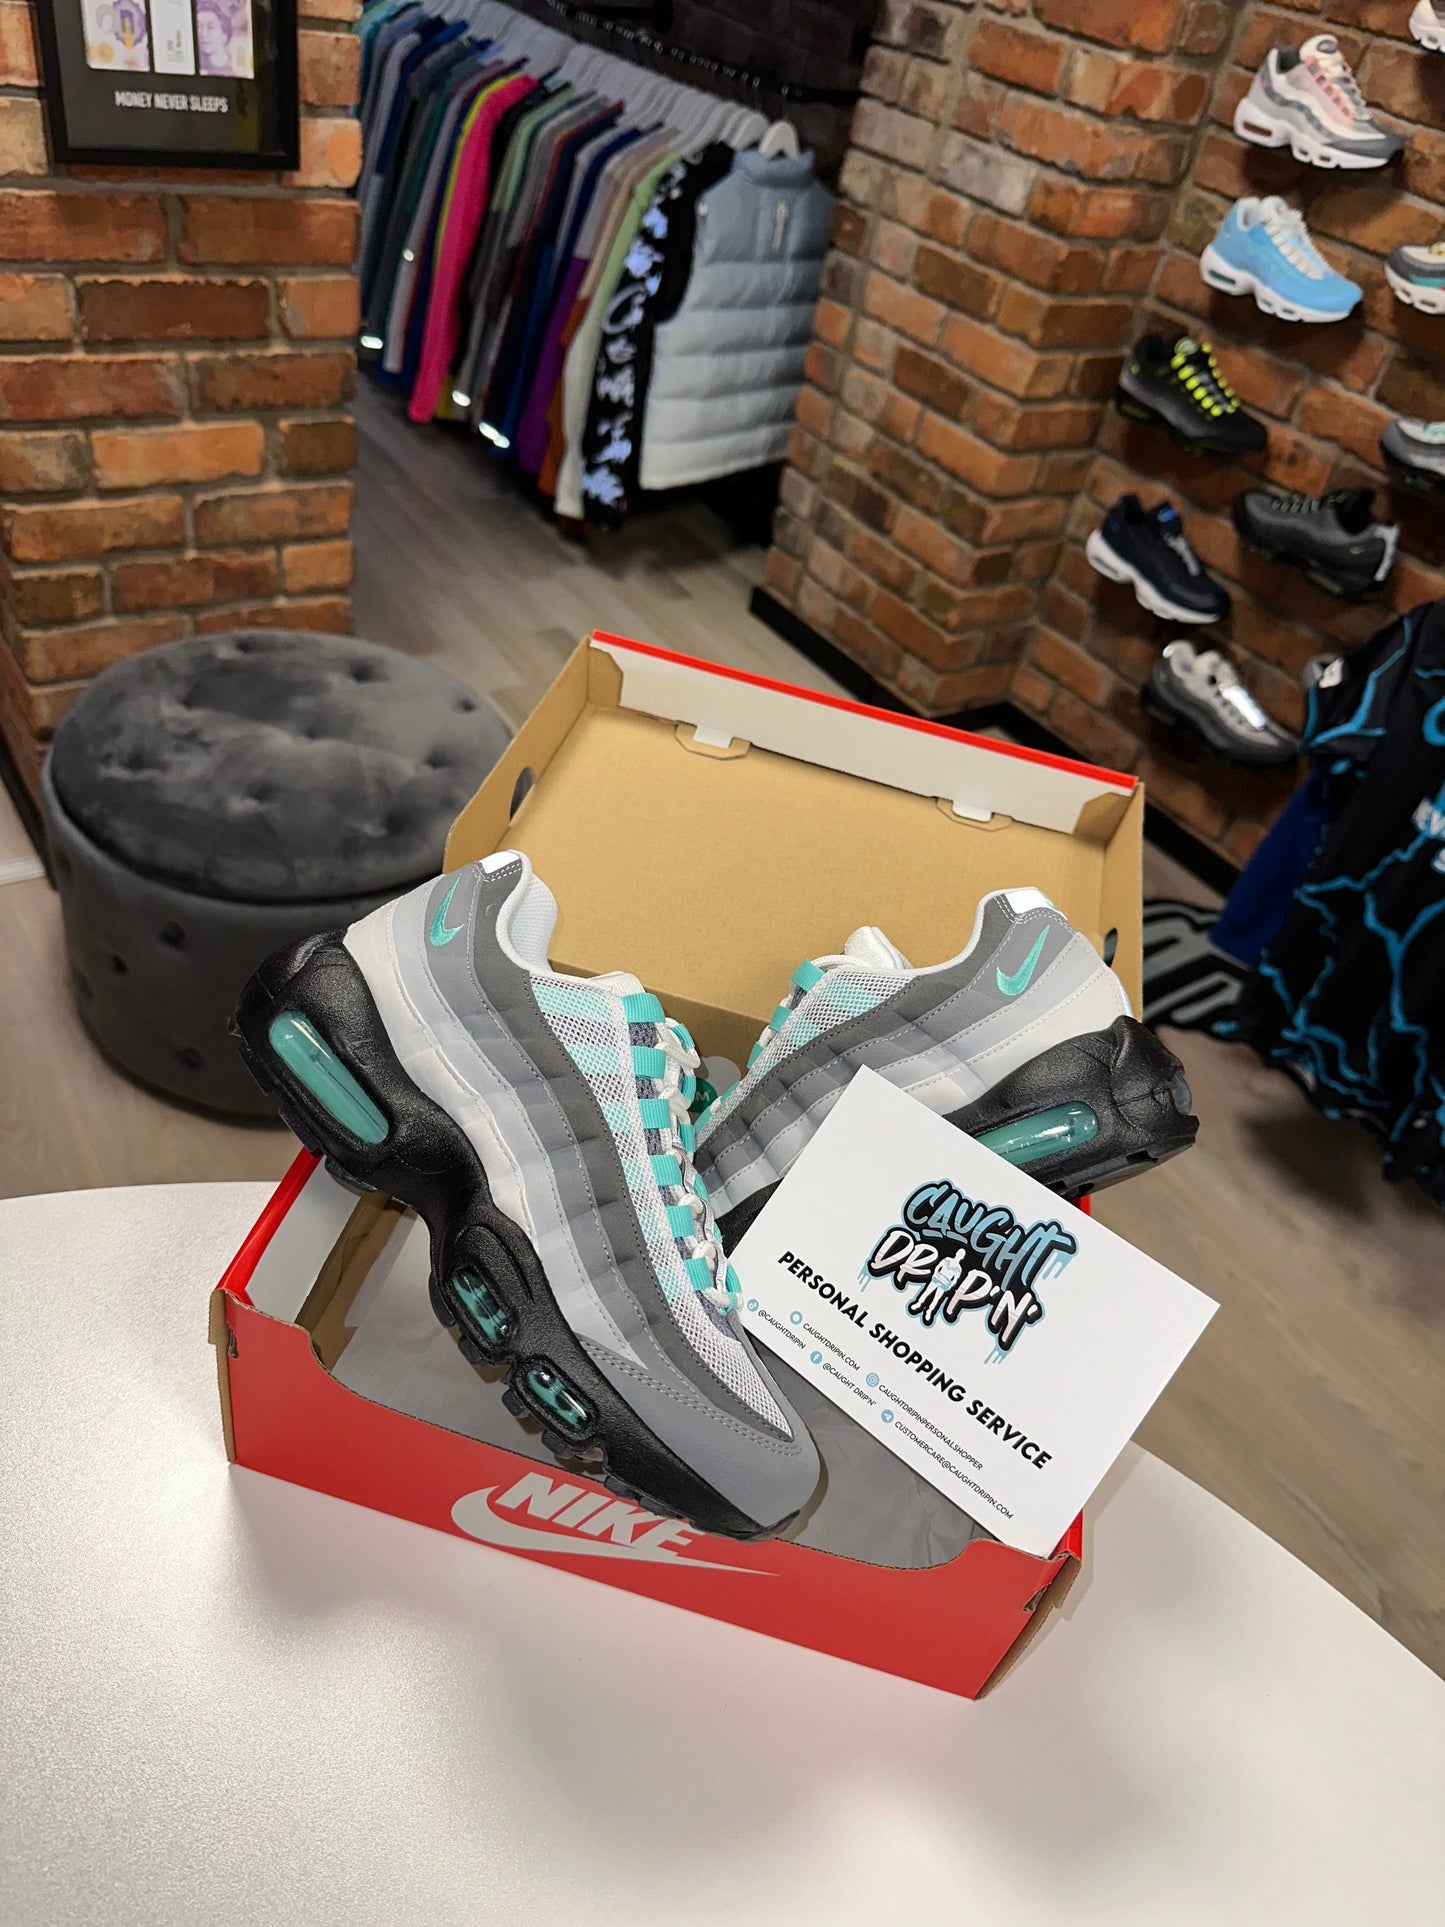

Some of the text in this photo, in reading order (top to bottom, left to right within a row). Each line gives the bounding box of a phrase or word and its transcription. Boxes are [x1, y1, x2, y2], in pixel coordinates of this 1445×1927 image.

[114, 91, 229, 113] MONEY NEVER SLEEPS
[904, 1180, 1075, 1292] CAUGHT
[758, 1309, 807, 1350] @CAUGHTDRIPIN
[778, 1250, 1052, 1469] PERSONAL SHOPPING SERVICE
[802, 1322, 861, 1372] CAUGHTDRIPIN.COM
[822, 1362, 855, 1390] @CAUGHT
[878, 1384, 983, 1471] CAUGHTDRIPINPERSONALSHOPPER
[894, 1421, 1014, 1519] CUSTOMERCARE@CAUGHTDRIPIN.COM
[495, 1472, 705, 1556] NIKE
